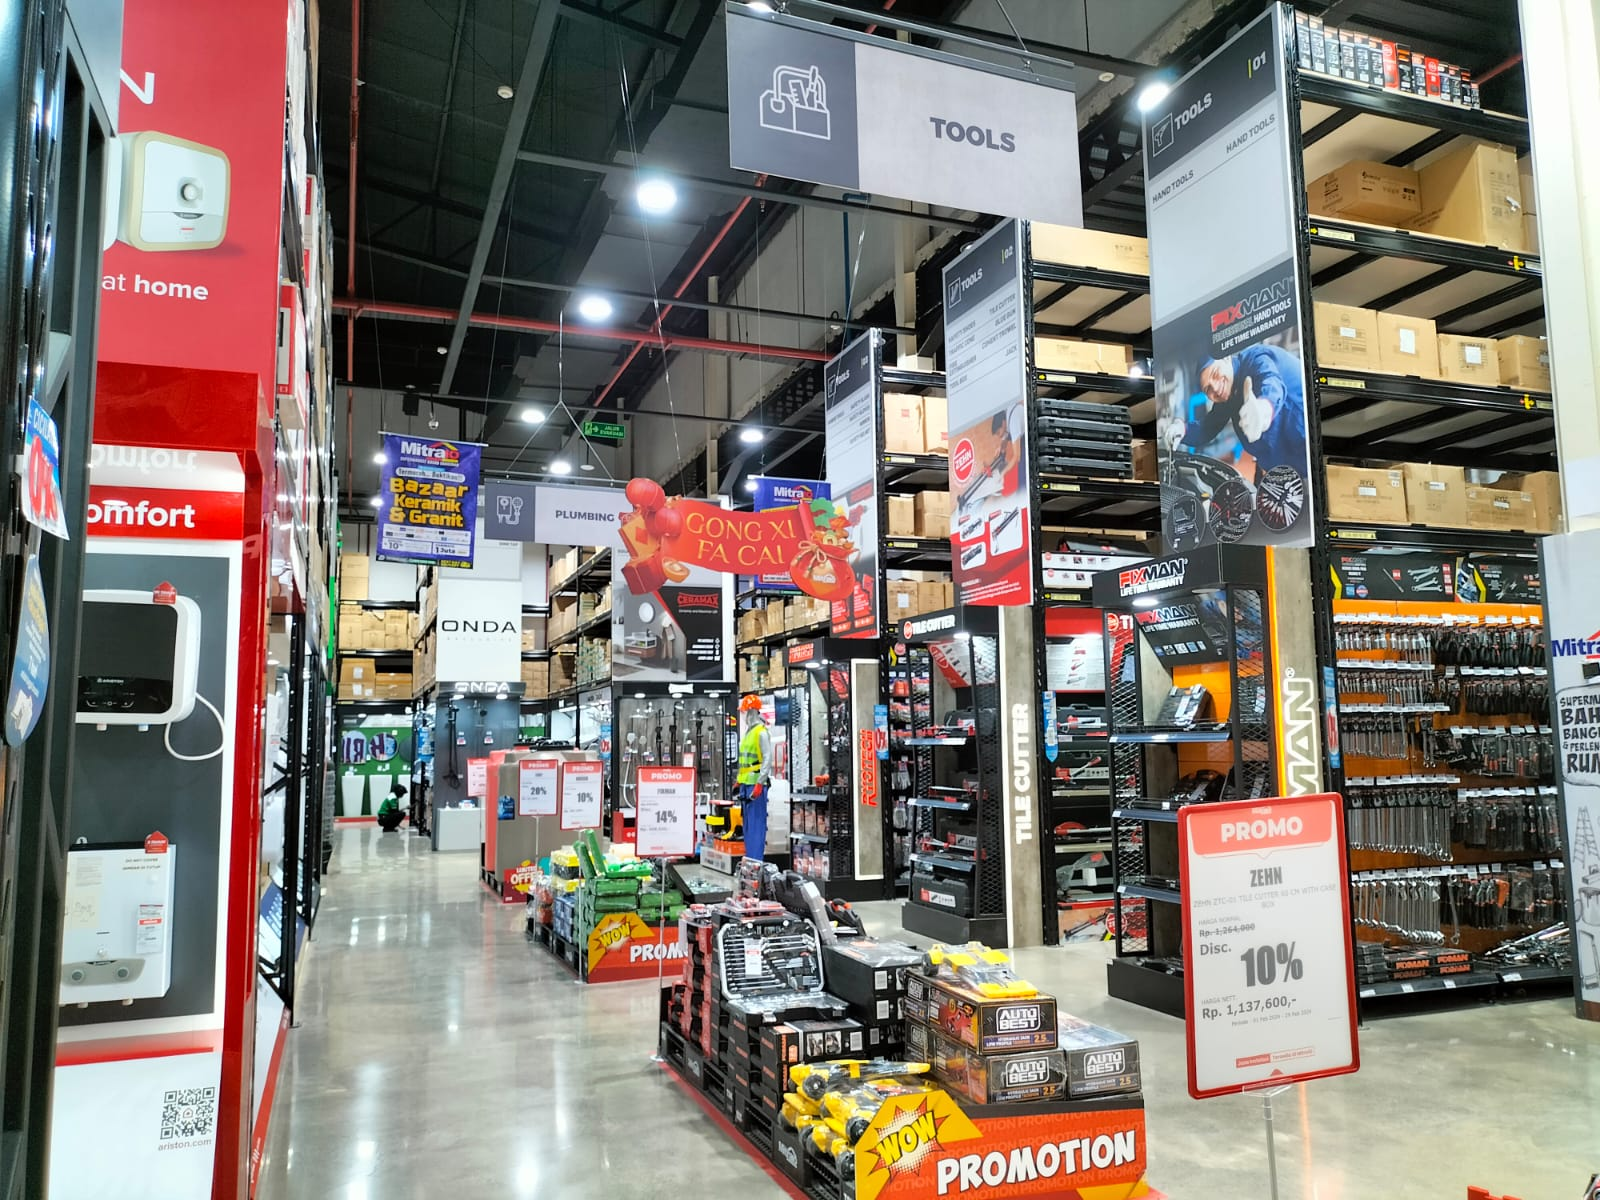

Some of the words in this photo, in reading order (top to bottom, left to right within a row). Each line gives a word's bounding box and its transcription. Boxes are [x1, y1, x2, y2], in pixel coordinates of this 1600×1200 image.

[1252, 51, 1267, 71] 01
[1174, 92, 1213, 131] TOOLS
[929, 116, 1016, 153] TOOLS
[1226, 132, 1249, 154] HAND
[1249, 113, 1276, 139] TOOLS
[1151, 185, 1171, 204] HAND
[1171, 169, 1195, 191] TOOLS
[1004, 246, 1013, 259] 02
[102, 273, 126, 291] at
[133, 274, 209, 300] home
[961, 268, 984, 292] TOOLS
[1253, 309, 1272, 324] HAND
[1271, 297, 1292, 316] TOOLS
[1221, 338, 1235, 351] LIFE
[1234, 331, 1250, 345] TIME
[1250, 313, 1287, 337] WARRANTY
[401, 441, 460, 460] Mitra10
[955, 448, 973, 470] ZEHN
[390, 477, 469, 498] Bazaar
[394, 493, 462, 513] Keramik
[389, 506, 406, 523] &
[409, 509, 464, 527] Granit
[555, 509, 615, 523] PLUMBING
[686, 512, 763, 542] GONG
[768, 519, 798, 541] XI
[697, 540, 731, 565] FA
[737, 544, 785, 567] CAI
[1119, 557, 1186, 588] FIXMAN
[1147, 575, 1184, 592] WARRANTY
[677, 593, 719, 608] CERAMAX
[1134, 603, 1197, 625] FIXMAN
[441, 620, 517, 634] ONDA
[454, 682, 511, 694] ONDA
[1563, 726, 1600, 740] BANG
[1011, 702, 1031, 793] CUTTER
[651, 772, 682, 781] PROMO
[530, 786, 547, 796] 20%
[577, 791, 594, 803] 10%
[655, 809, 678, 824] 14%
[1014, 795, 1033, 845] TILE
[1221, 816, 1304, 844] PROMO
[1249, 865, 1284, 888] ZEHN
[1302, 886, 1319, 895] WITH
[599, 922, 631, 948] WOW
[1199, 929, 1213, 938] Rp.
[1215, 923, 1256, 936] 1,264,000
[1200, 940, 1232, 956] Disc.
[1240, 941, 1304, 988] 10%
[999, 1007, 1038, 1020] AUTO
[1202, 1006, 1222, 1021] Rp.
[1226, 995, 1297, 1016] 1,137,600,-
[999, 1018, 1038, 1030] BEST
[1033, 1033, 1047, 1043] 2.5
[1008, 1060, 1046, 1073] AUTO
[1087, 1051, 1122, 1065] AUTO
[1009, 1071, 1046, 1084] BEST
[1087, 1062, 1122, 1075] BEST
[1042, 1085, 1056, 1095] 2.5
[158, 1137, 212, 1152] ariston.com
[876, 1110, 937, 1167] WOW
[936, 1129, 1137, 1196] PROMOTION
